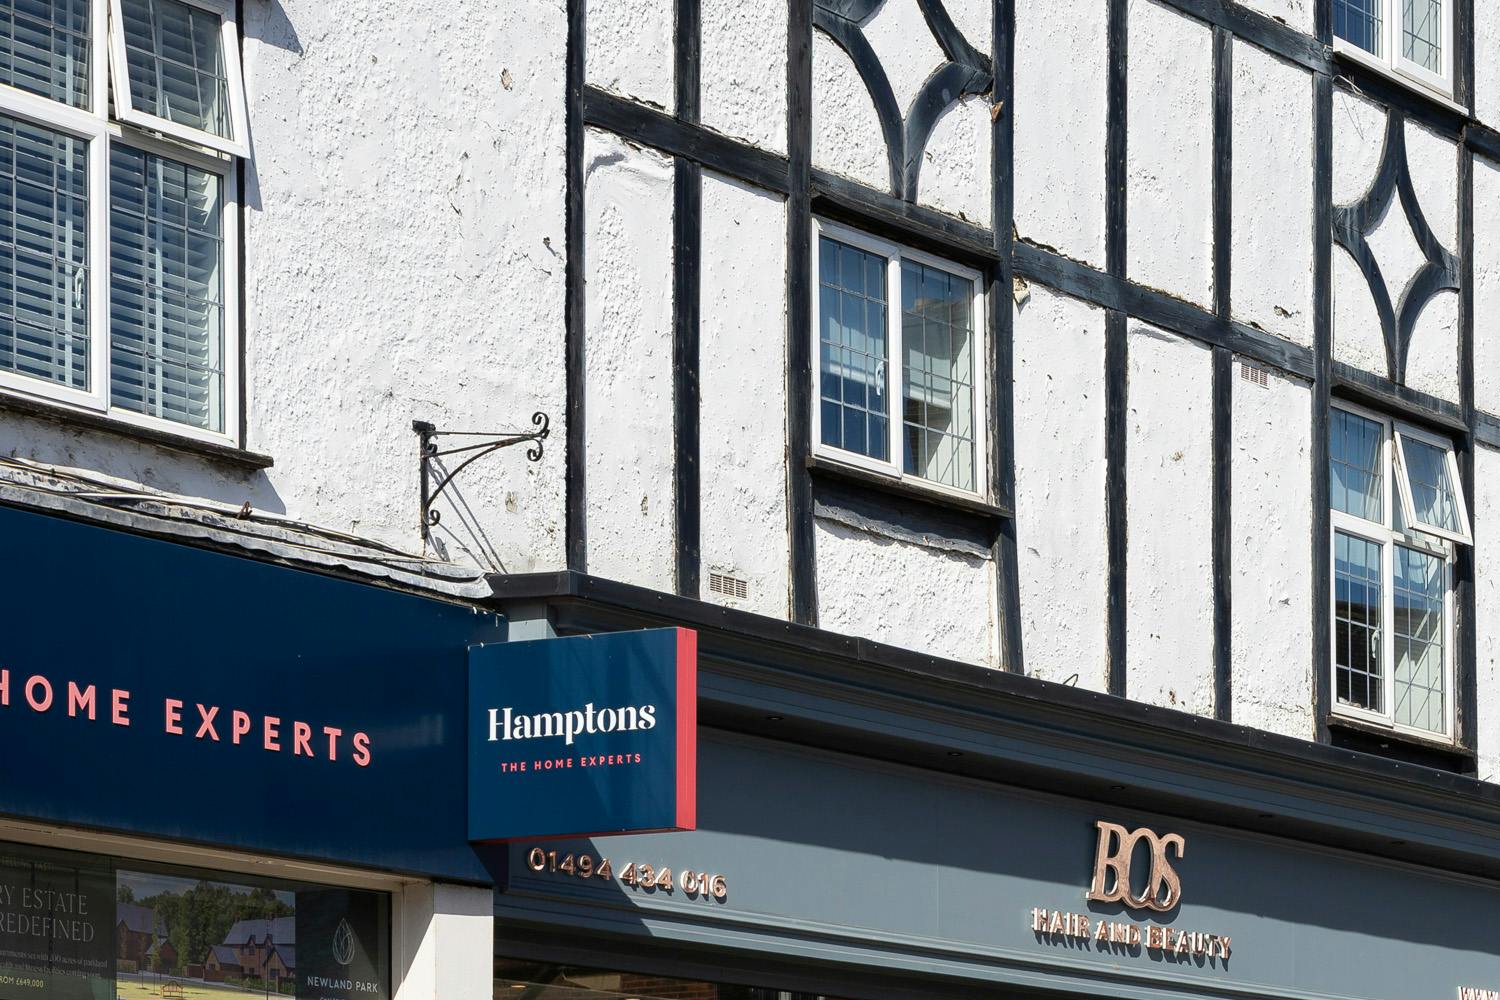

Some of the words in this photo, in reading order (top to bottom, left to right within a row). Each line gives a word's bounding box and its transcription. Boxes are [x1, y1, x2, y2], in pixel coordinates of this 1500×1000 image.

[164, 698, 371, 767] EXPERTS
[488, 702, 656, 745] Hamptons
[501, 761, 526, 773] THE
[534, 758, 573, 770] HOME
[581, 753, 641, 767] EXPERTS
[528, 847, 612, 880] 01494
[619, 862, 673, 890] 434
[680, 870, 727, 898] 016
[1086, 820, 1185, 912] BOS
[22, 887, 88, 915] ESTATE
[1031, 907, 1090, 938] HAIR
[1095, 920, 1141, 945] AND
[1145, 925, 1232, 959] BEAUTY
[307, 976, 353, 990] NEWLAND
[355, 981, 378, 993] PARK
